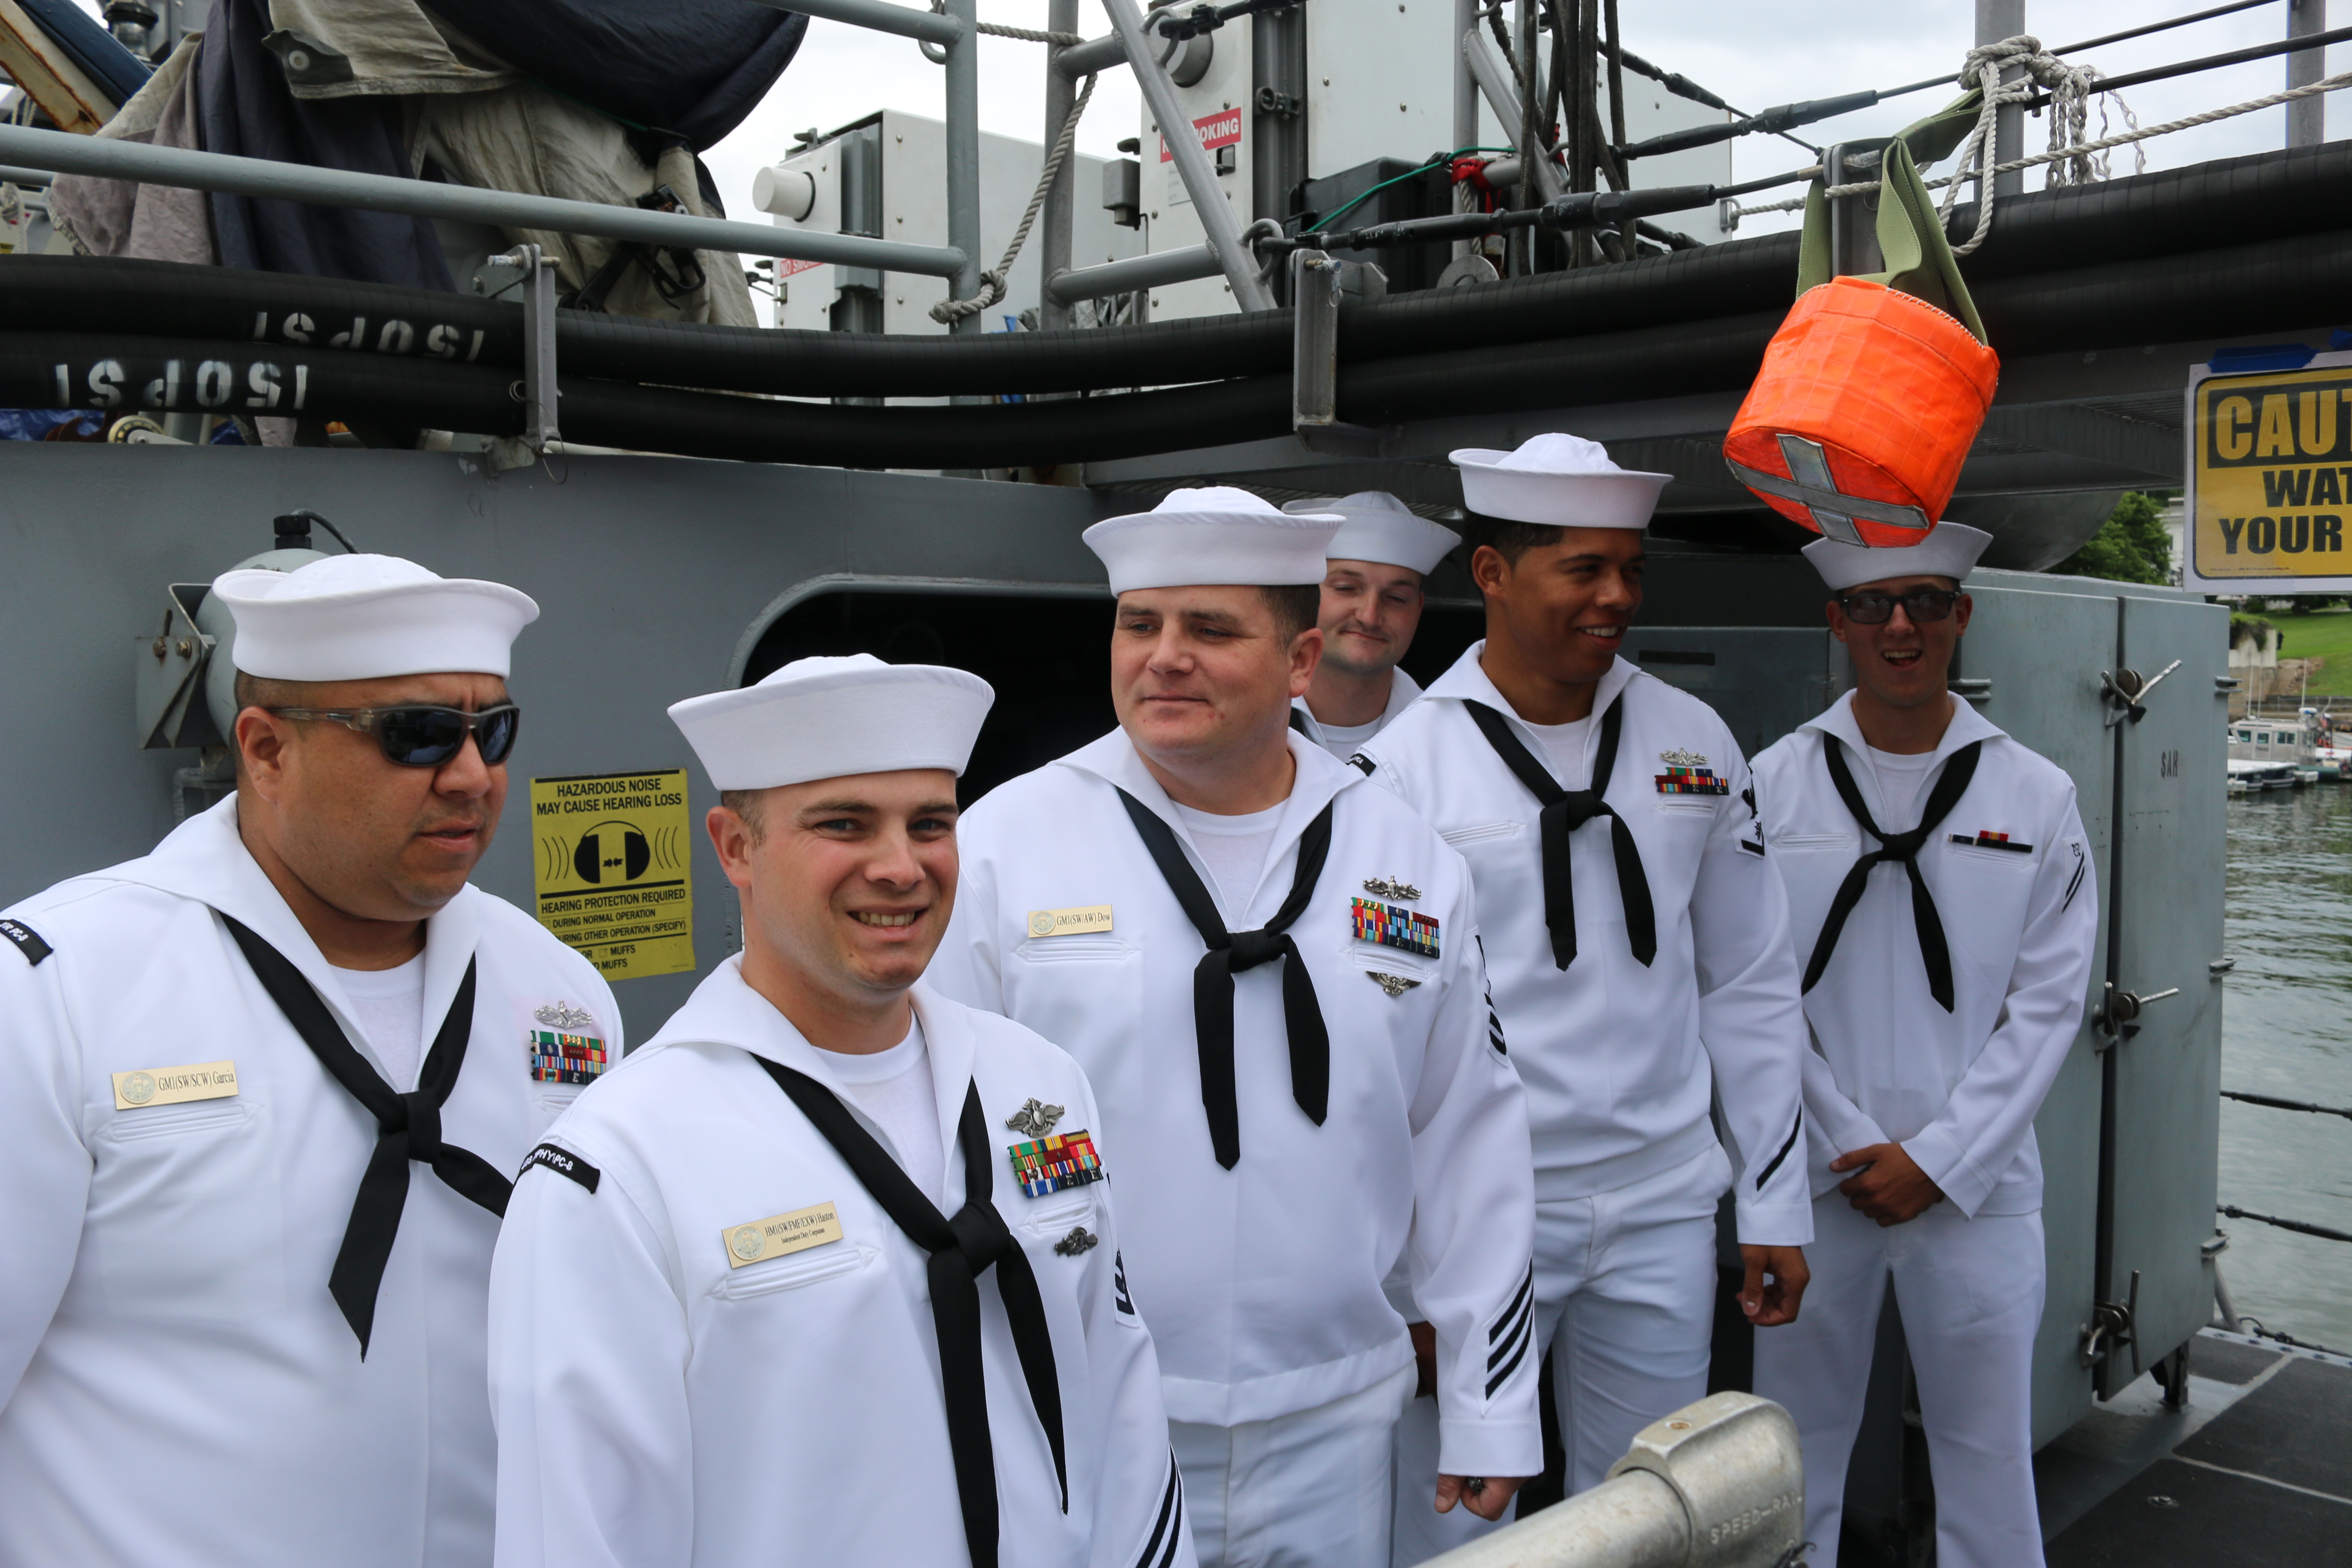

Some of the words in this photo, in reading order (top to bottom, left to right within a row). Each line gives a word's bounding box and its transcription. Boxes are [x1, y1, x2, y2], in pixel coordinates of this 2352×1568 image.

[2216, 389, 2352, 460] CAU
[2218, 514, 2342, 554] YOUR
[557, 781, 625, 797] HAZARDOUS
[629, 778, 661, 792] NOISE
[537, 802, 561, 815] MAY
[564, 799, 600, 813] CAUSE
[603, 796, 651, 810] HEARING
[655, 793, 682, 806] LOSS
[542, 898, 582, 914] HEARING
[584, 894, 639, 910] PROTECTION
[642, 888, 685, 904] REQUIRED
[553, 917, 581, 928] DURING
[583, 913, 614, 924] NORMAL
[616, 909, 655, 921] OPERATION
[1057, 913, 1096, 927] GM1(SW/AW)
[1097, 912, 1111, 922] Dow
[584, 929, 608, 940] OTHER
[610, 925, 650, 937] OPERATION
[652, 920, 686, 934] (SPECIFY)
[610, 945, 635, 956] MUFFS
[602, 959, 627, 970] MUFFS
[159, 1072, 212, 1092] GM1(SW/SCW)
[213, 1069, 234, 1085] Garcia
[817, 1212, 834, 1223] Haston
[781, 1234, 801, 1244] Independent
[808, 1228, 825, 1237] Corpsman
